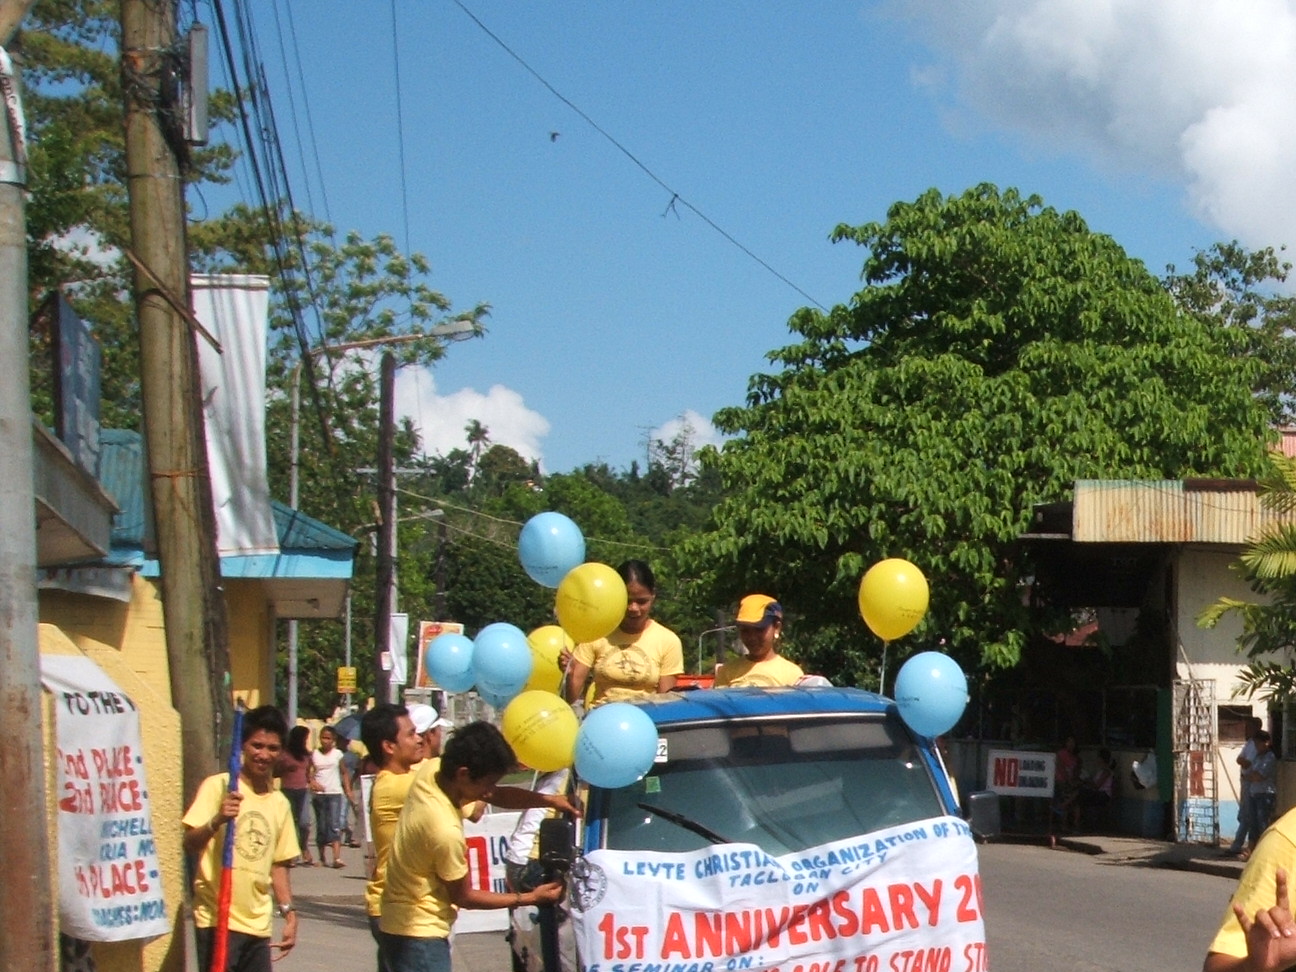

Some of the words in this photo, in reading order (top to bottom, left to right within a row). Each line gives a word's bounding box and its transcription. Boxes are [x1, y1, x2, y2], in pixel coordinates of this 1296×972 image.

[63, 691, 89, 715] TO
[88, 691, 125, 714] THE
[993, 757, 1018, 787] NO
[623, 861, 686, 880] LEYTE
[695, 850, 780, 880] CHRISTIA
[792, 827, 928, 872] ORGANIZATION
[933, 822, 949, 838] OF
[842, 851, 887, 876] CITY
[89, 860, 149, 898] PLACE
[793, 882, 819, 895] ON
[598, 912, 649, 959] 1ST
[661, 878, 943, 959] ANNIVERSARY
